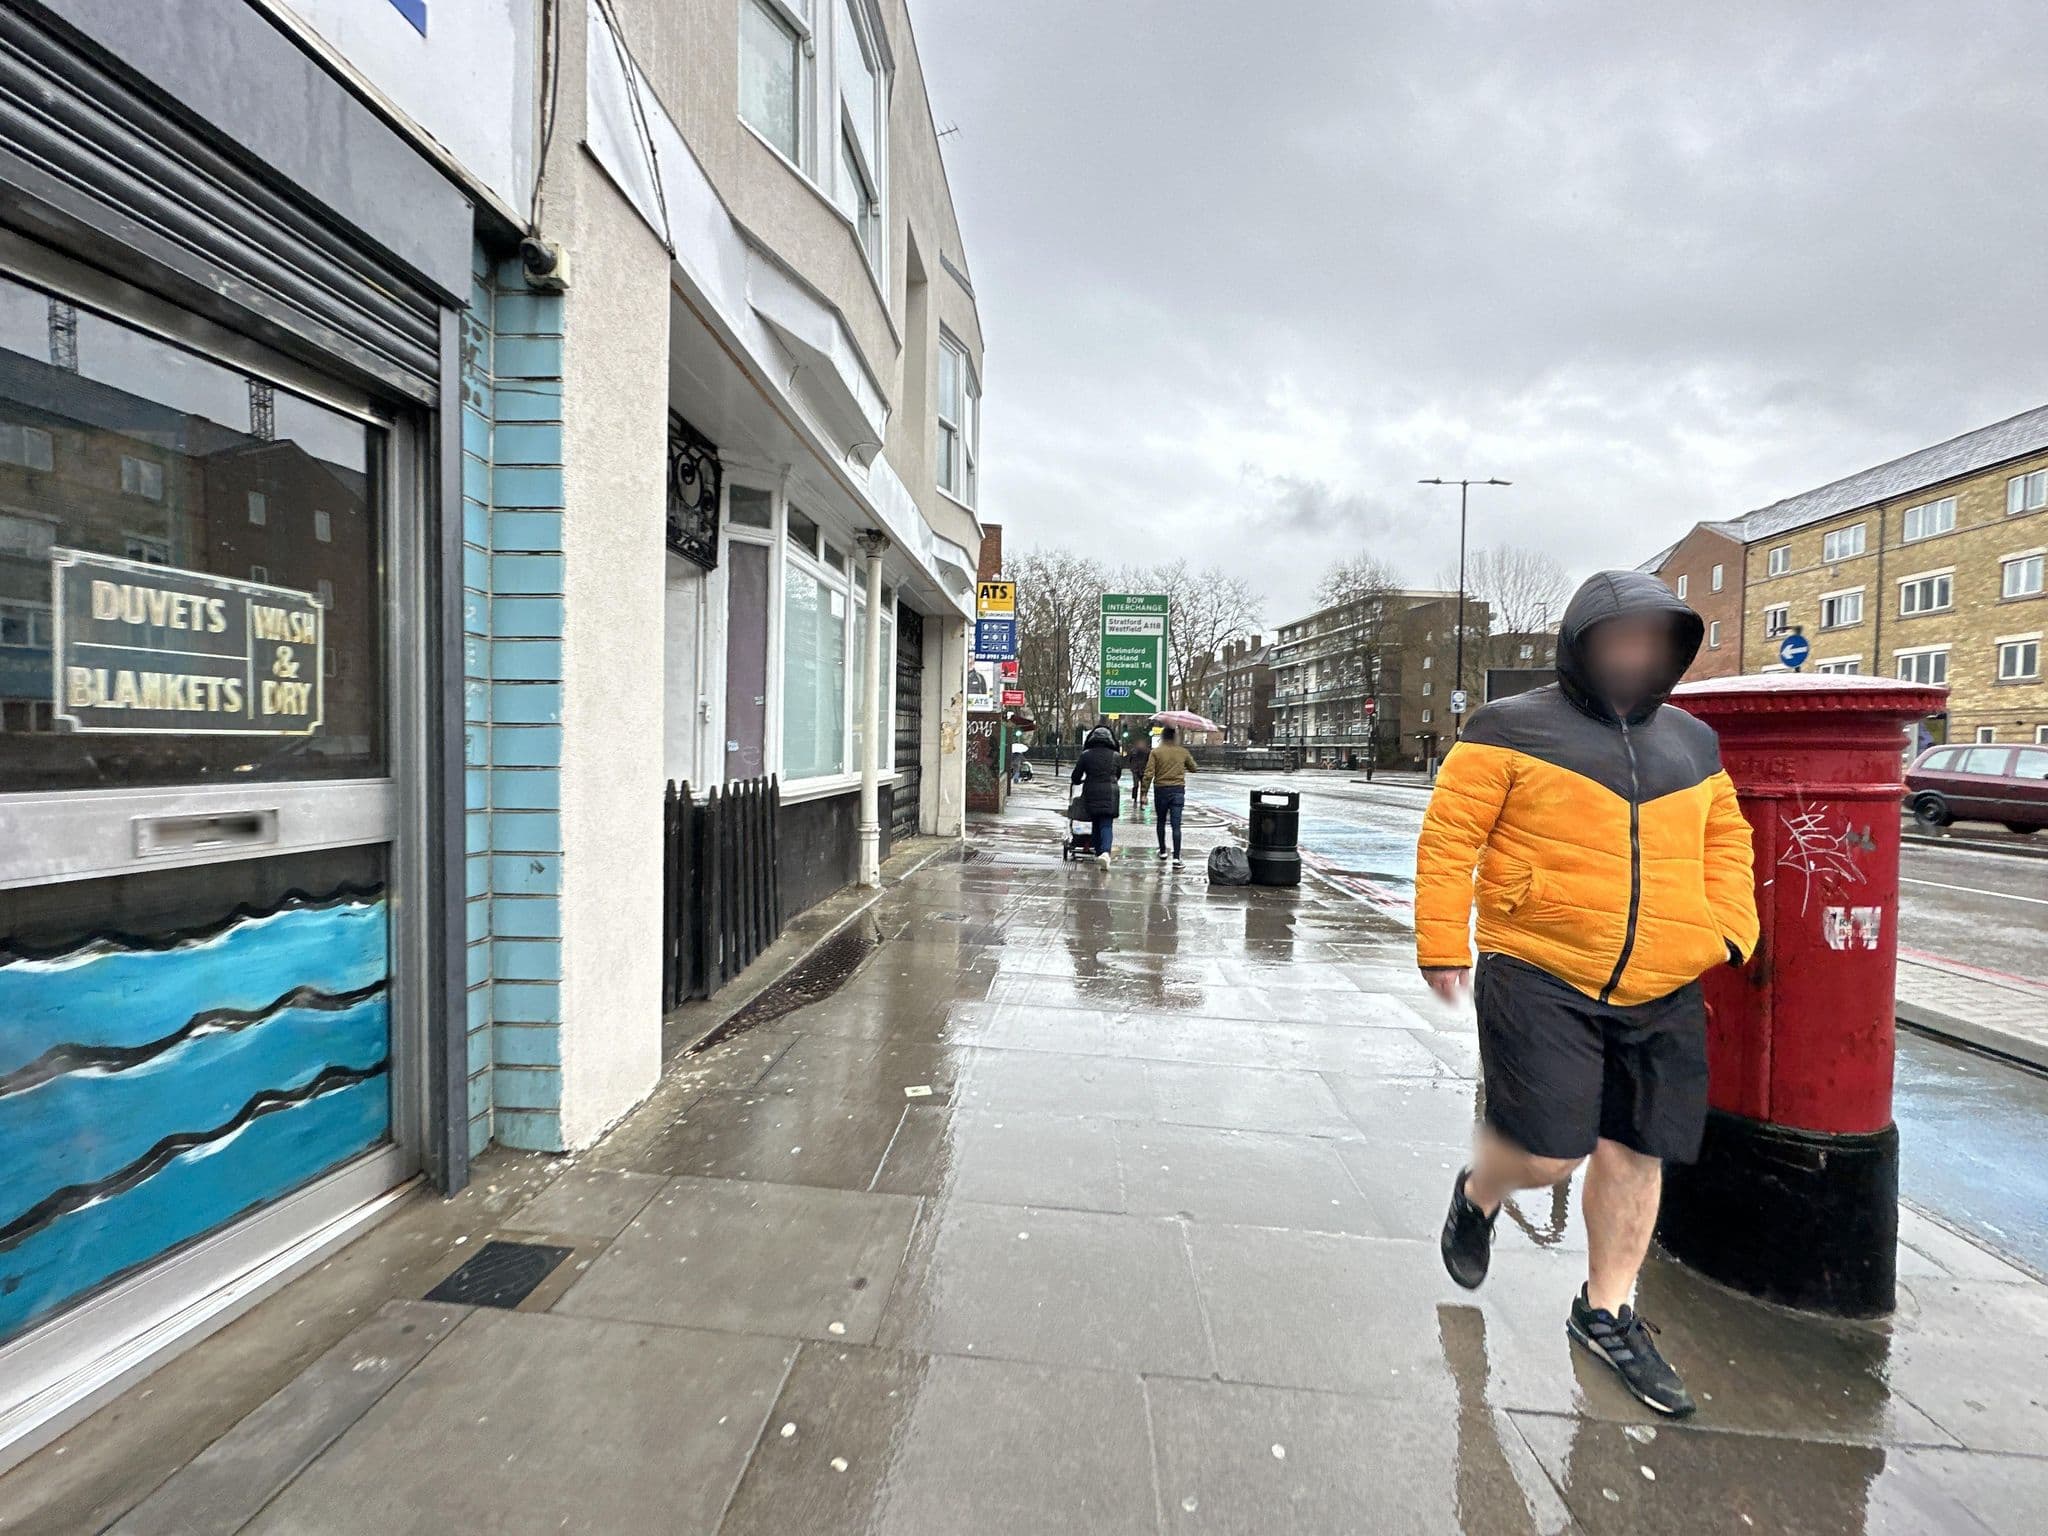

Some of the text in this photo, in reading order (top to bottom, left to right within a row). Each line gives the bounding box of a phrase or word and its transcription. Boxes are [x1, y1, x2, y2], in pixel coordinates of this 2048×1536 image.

[980, 584, 1008, 600] ATS
[91, 580, 227, 633] DUVETS
[253, 605, 316, 644] WASH
[1108, 625, 1142, 633] Westfield
[1143, 622, 1161, 630] A118
[272, 645, 300, 678] &
[1106, 647, 1146, 655] Chelmsford
[1105, 661, 1140, 669] Blackwall
[66, 666, 242, 713] BLANKETS
[260, 679, 313, 716] DRY
